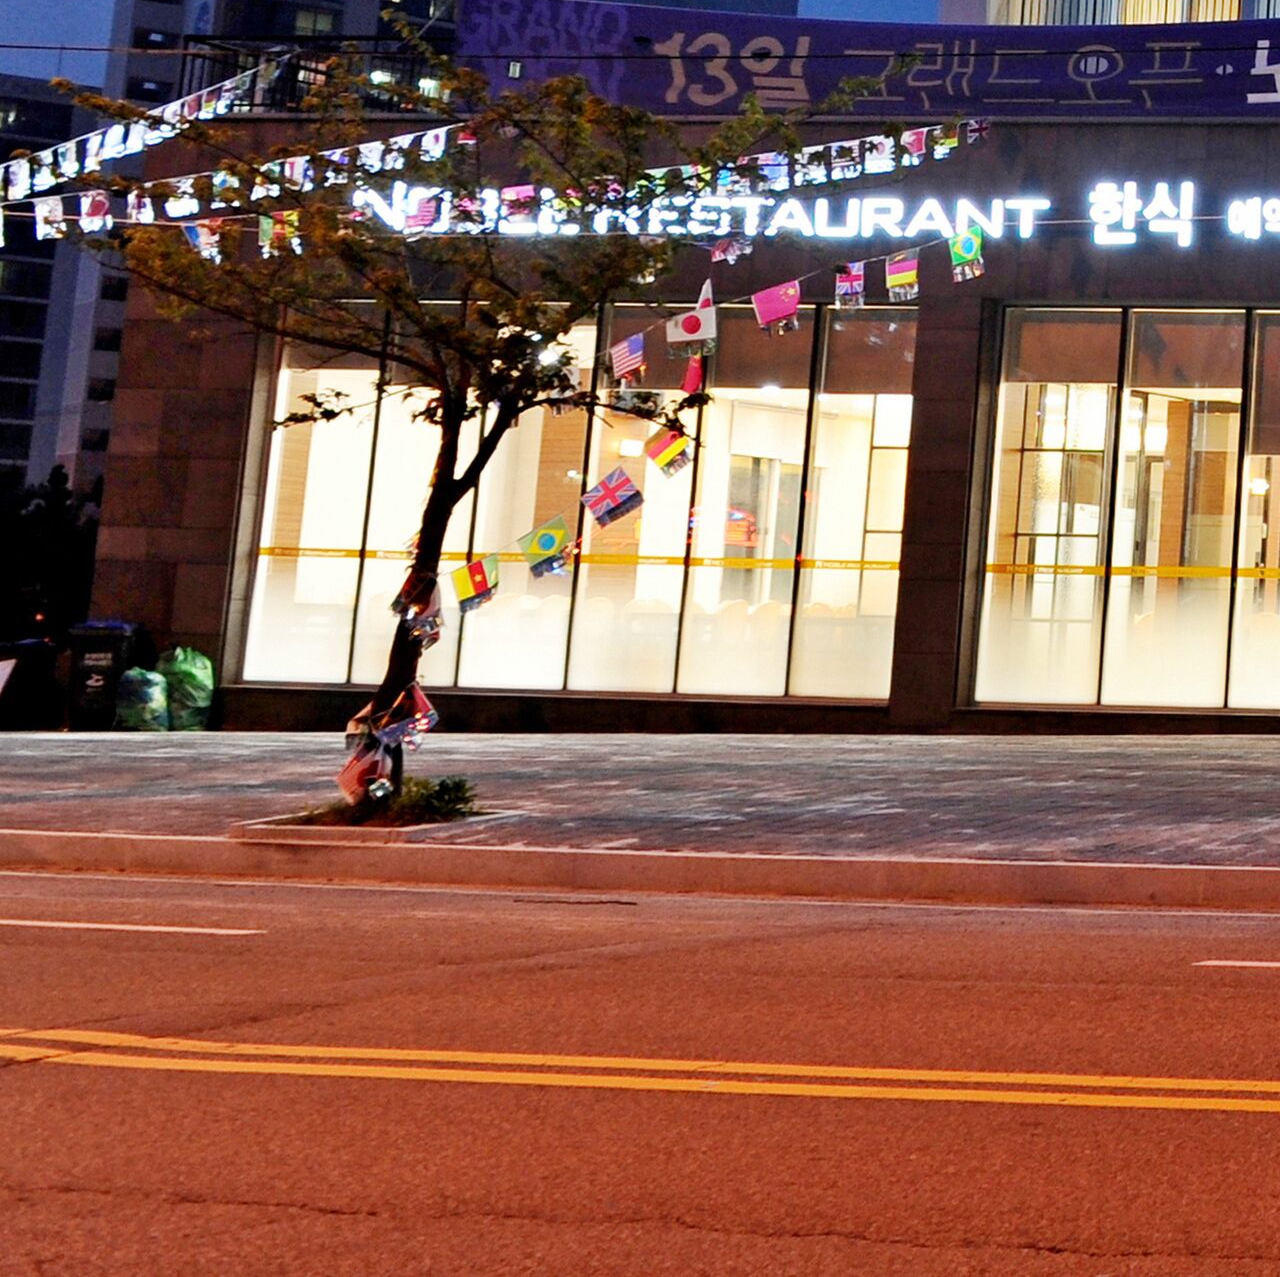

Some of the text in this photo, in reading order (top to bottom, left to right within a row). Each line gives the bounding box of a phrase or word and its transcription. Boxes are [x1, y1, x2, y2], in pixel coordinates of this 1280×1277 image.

[653, 31, 810, 109] 13일
[592, 195, 1052, 239] RESTAURANT
[1088, 180, 1195, 248] 한식
